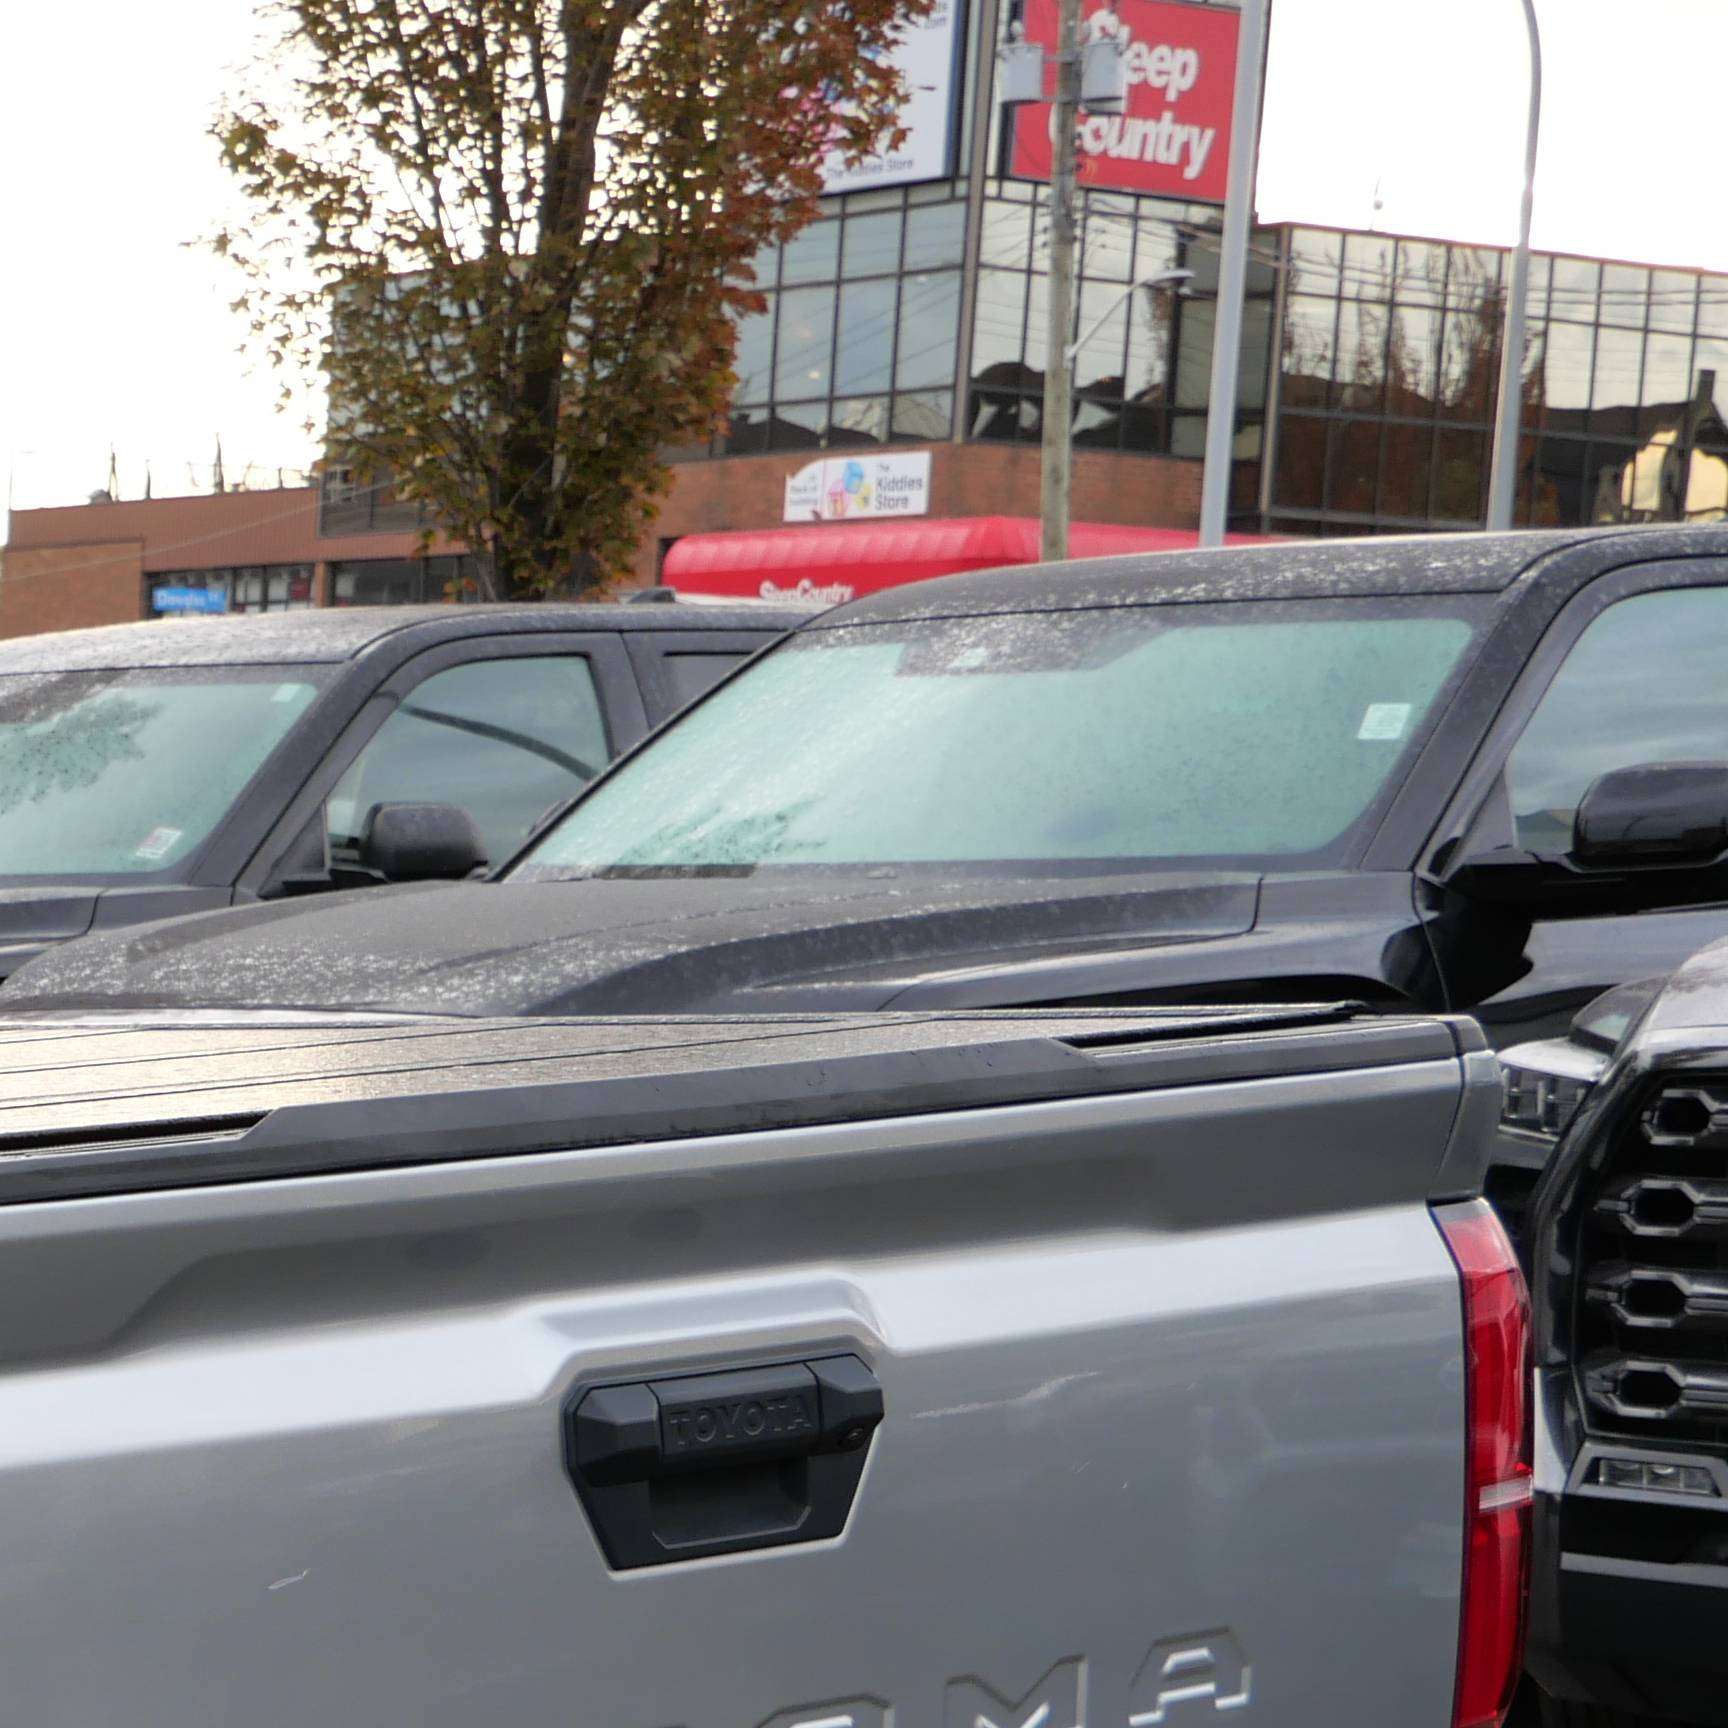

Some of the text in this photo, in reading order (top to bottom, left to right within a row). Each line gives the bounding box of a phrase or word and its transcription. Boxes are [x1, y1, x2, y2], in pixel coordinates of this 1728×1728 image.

[876, 476, 923, 492] Kiddies
[875, 494, 909, 511] Store
[668, 1396, 815, 1447] TOYOTA
